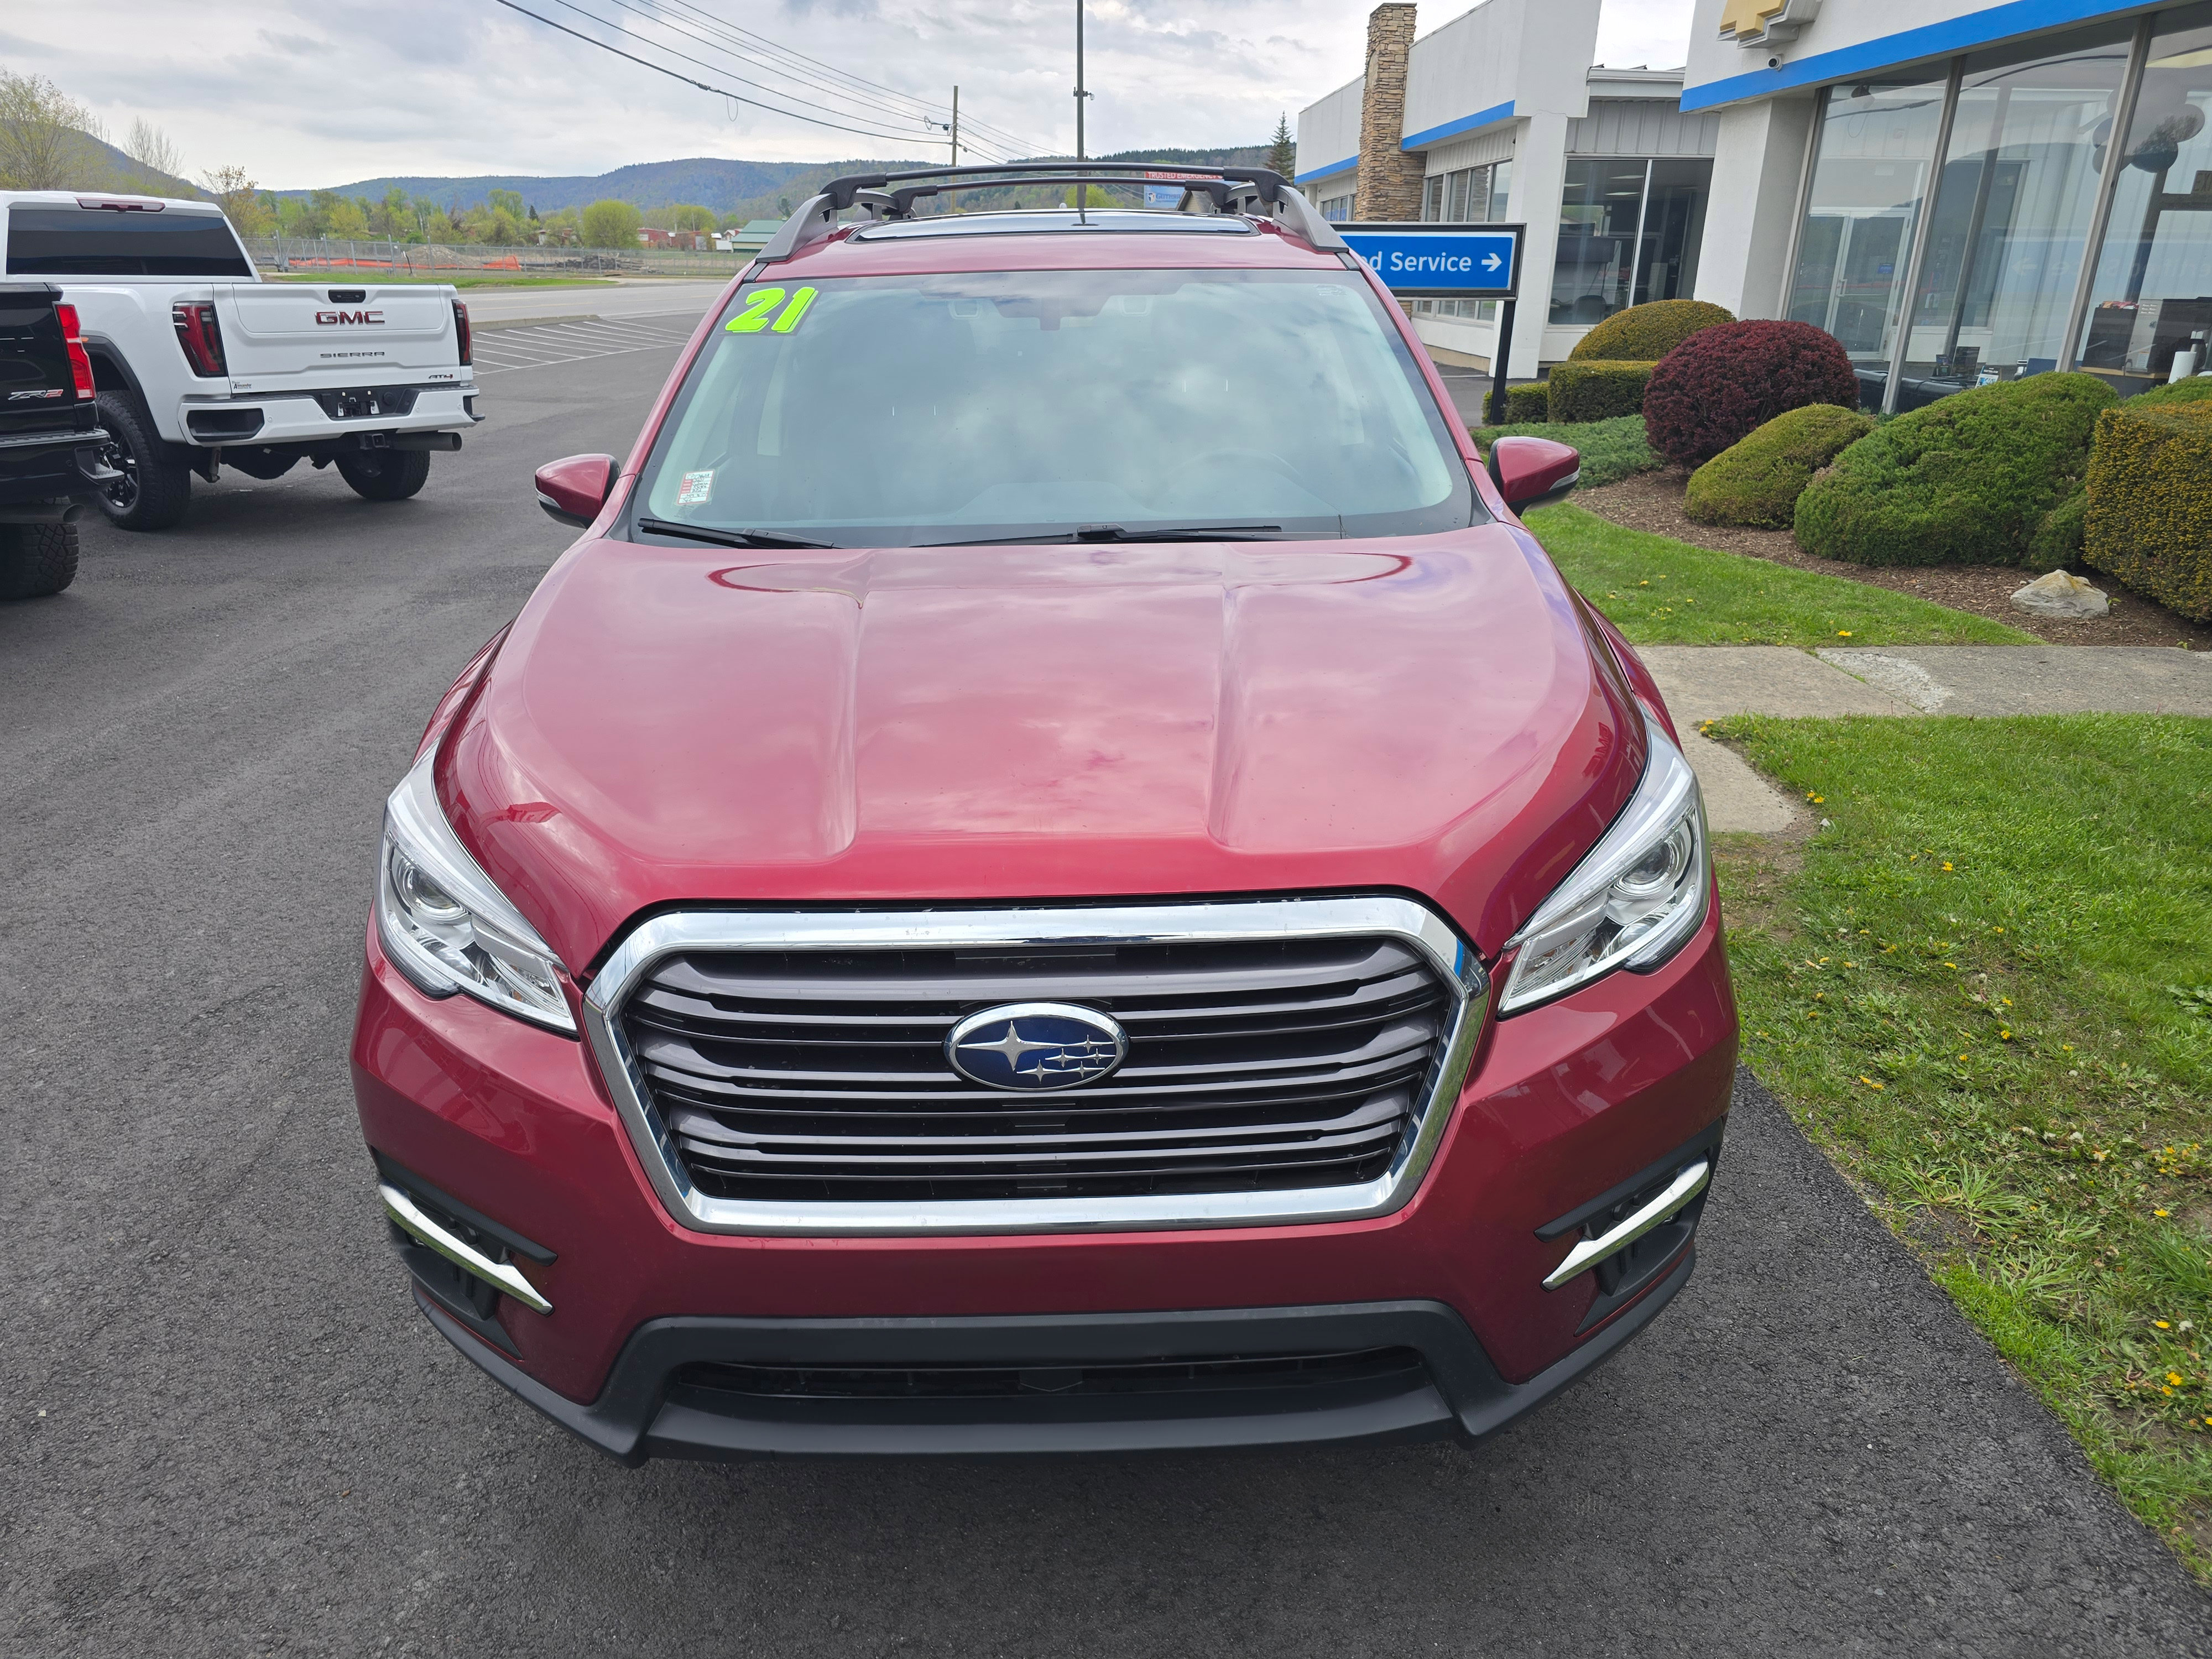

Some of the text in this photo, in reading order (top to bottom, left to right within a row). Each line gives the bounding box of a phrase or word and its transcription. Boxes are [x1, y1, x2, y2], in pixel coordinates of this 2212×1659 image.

[1390, 252, 1472, 272] Service
[314, 311, 385, 325] GMC
[725, 287, 819, 333] 21
[8, 389, 64, 400] ZR2
